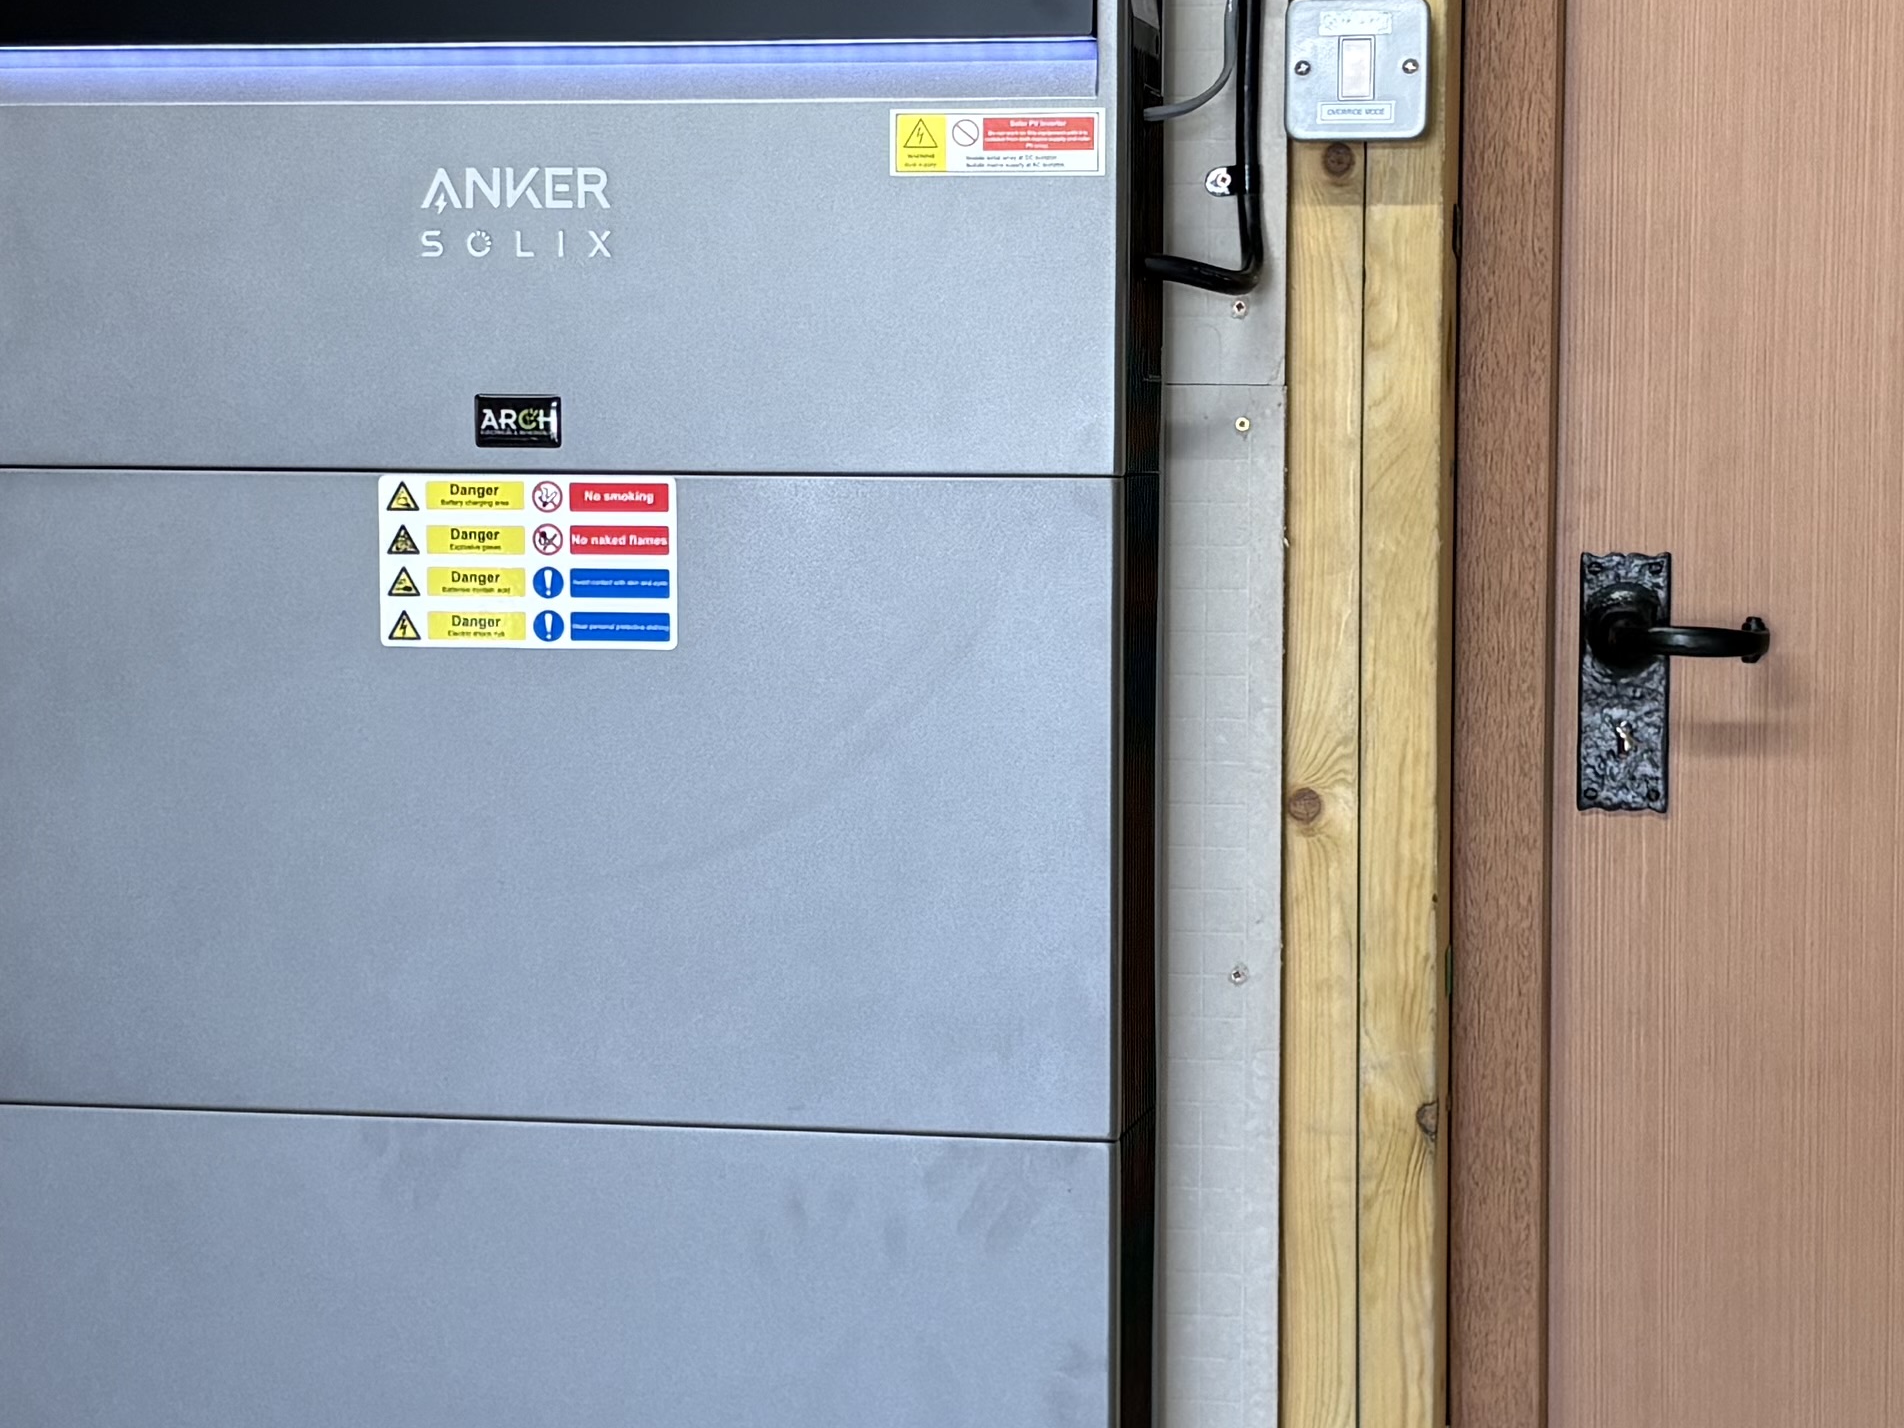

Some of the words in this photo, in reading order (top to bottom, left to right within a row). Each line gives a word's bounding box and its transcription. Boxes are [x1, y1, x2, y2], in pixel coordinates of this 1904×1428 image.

[420, 167, 611, 213] ANKER
[420, 230, 611, 257] SOLIX
[480, 408, 557, 430] ARCH
[450, 483, 499, 498] Danger
[584, 490, 601, 501] No
[603, 491, 654, 504] smoking
[450, 528, 500, 543] Danger
[571, 534, 588, 545] No
[591, 535, 626, 545] naked
[629, 535, 667, 545] flames
[452, 571, 500, 585] Danger
[452, 615, 501, 629] Danger
